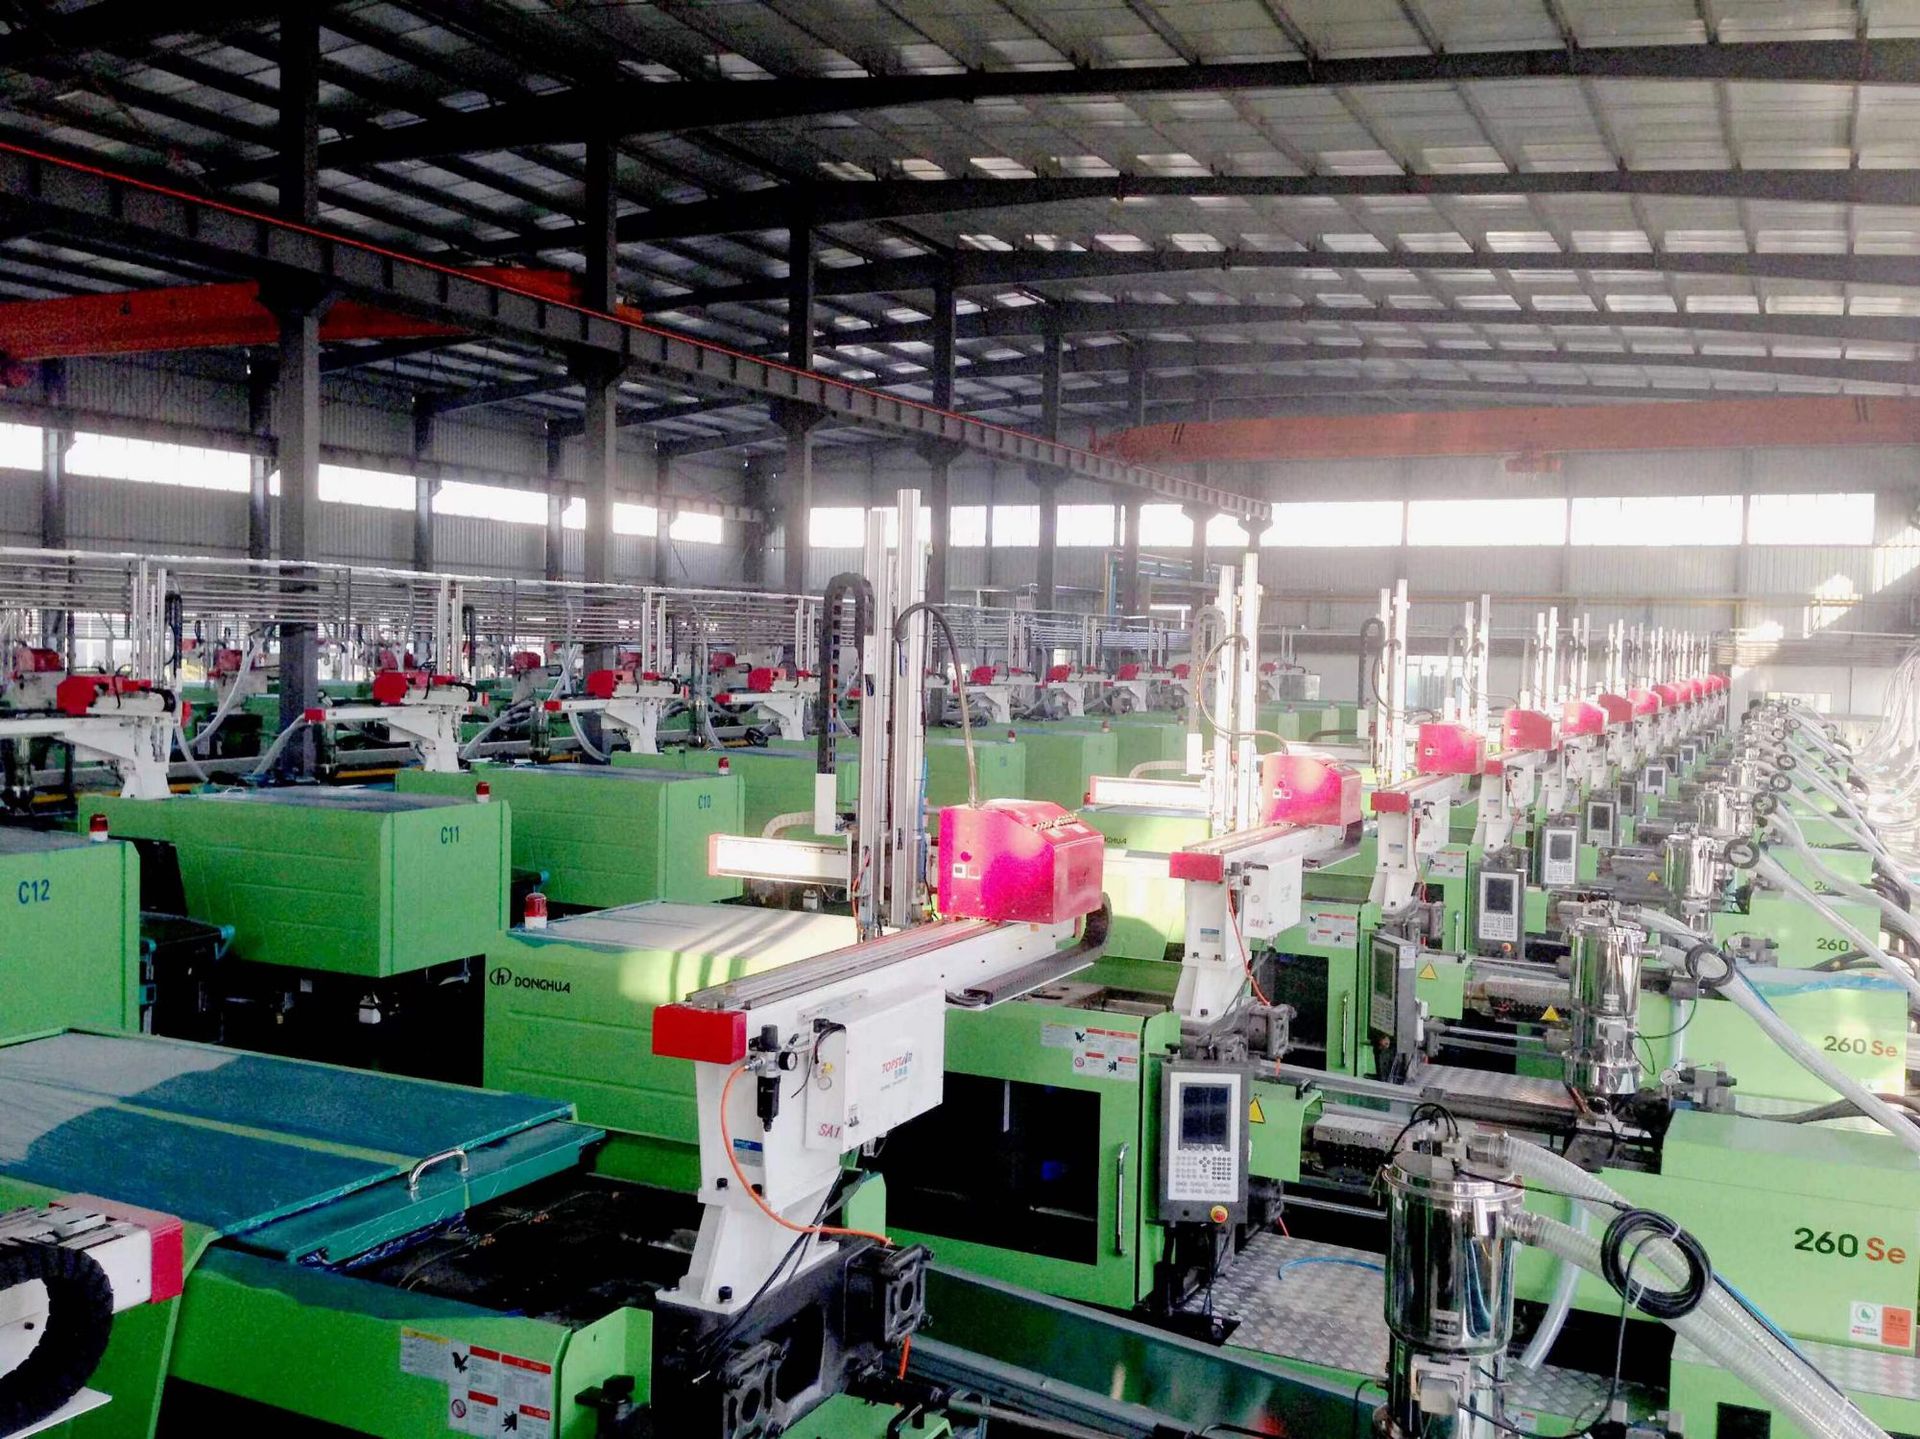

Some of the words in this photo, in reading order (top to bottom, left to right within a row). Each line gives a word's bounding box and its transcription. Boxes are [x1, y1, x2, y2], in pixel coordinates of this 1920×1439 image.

[440, 825, 460, 845] C11
[18, 879, 51, 905] C12
[1816, 937, 1849, 952] 260
[514, 976, 571, 994] DONGHUA
[1823, 1035, 1867, 1055] 260
[1871, 1040, 1898, 1057] Se
[1794, 1227, 1859, 1258] 260
[1865, 1236, 1907, 1264] Se
